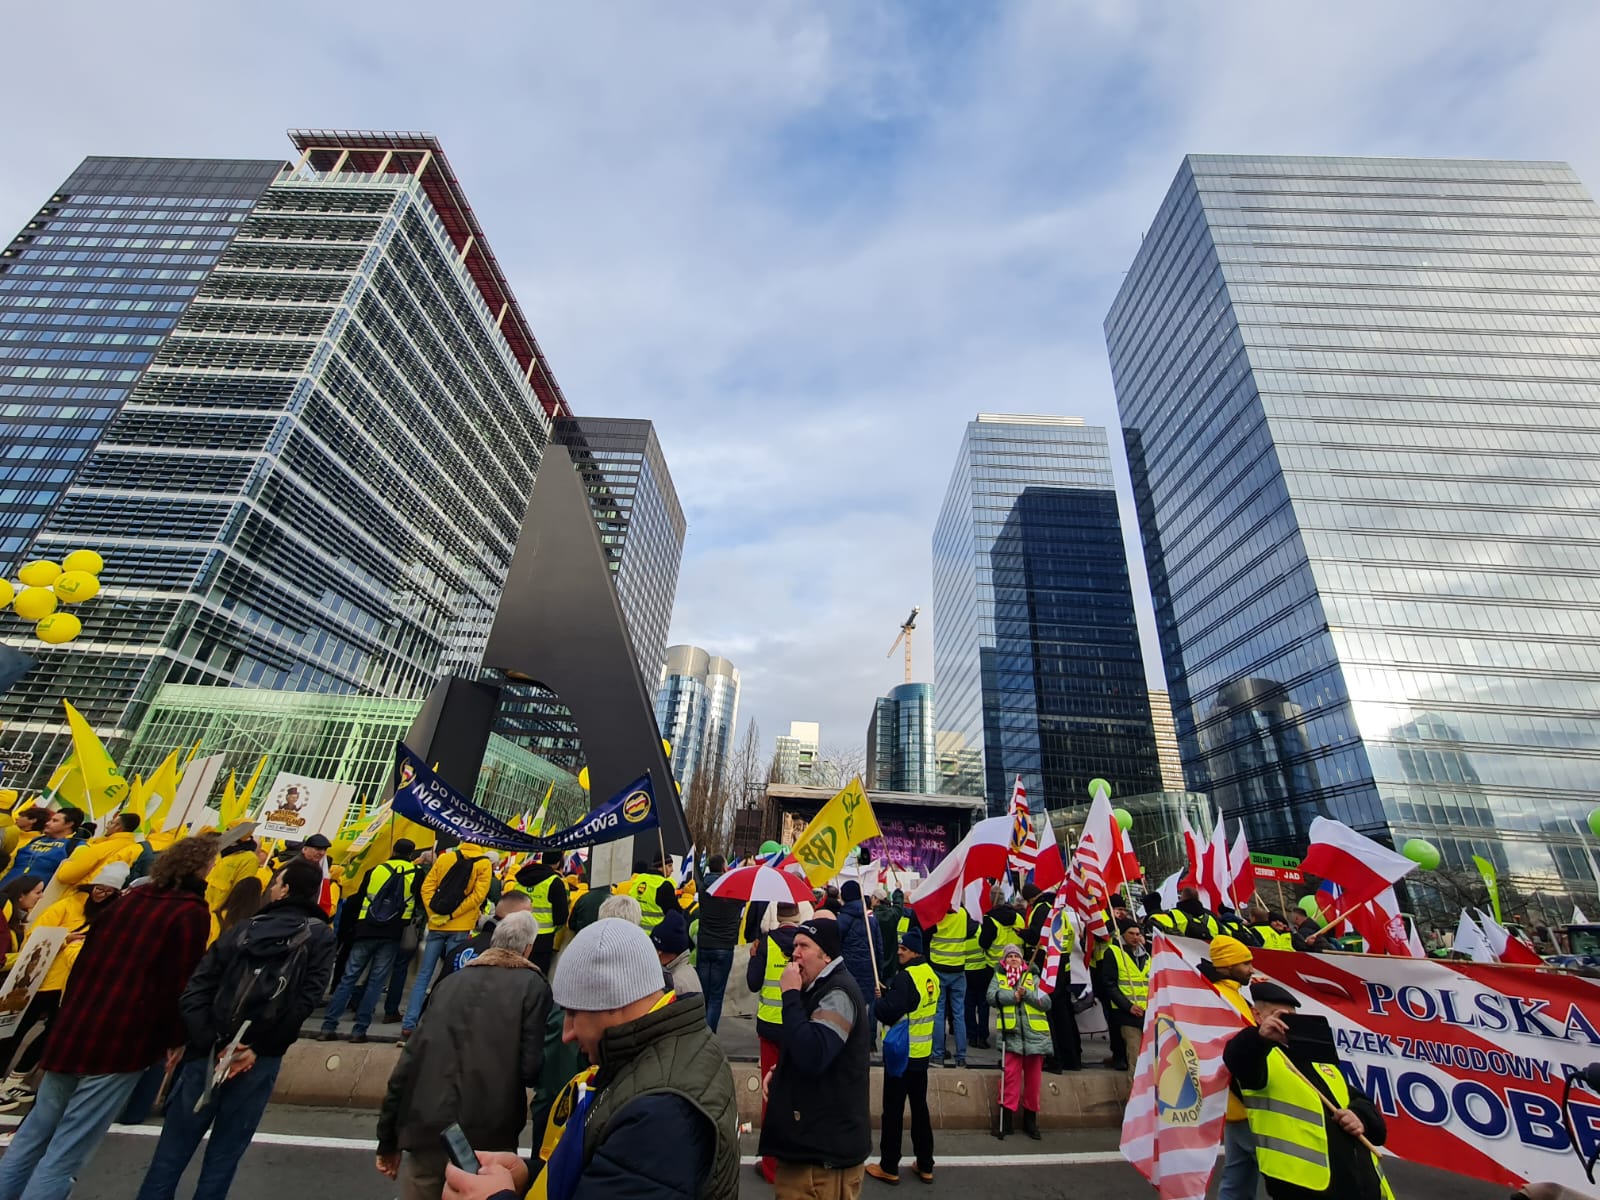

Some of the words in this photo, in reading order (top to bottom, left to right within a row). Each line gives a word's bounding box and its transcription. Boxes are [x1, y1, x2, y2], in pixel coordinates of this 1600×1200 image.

[411, 783, 442, 811] Nie
[430, 780, 448, 797] DO
[450, 796, 476, 816] NOT
[1361, 980, 1600, 1047] POLSKA
[1336, 1027, 1393, 1056] ĄZEK
[1397, 1037, 1551, 1084] ZAWODOWY
